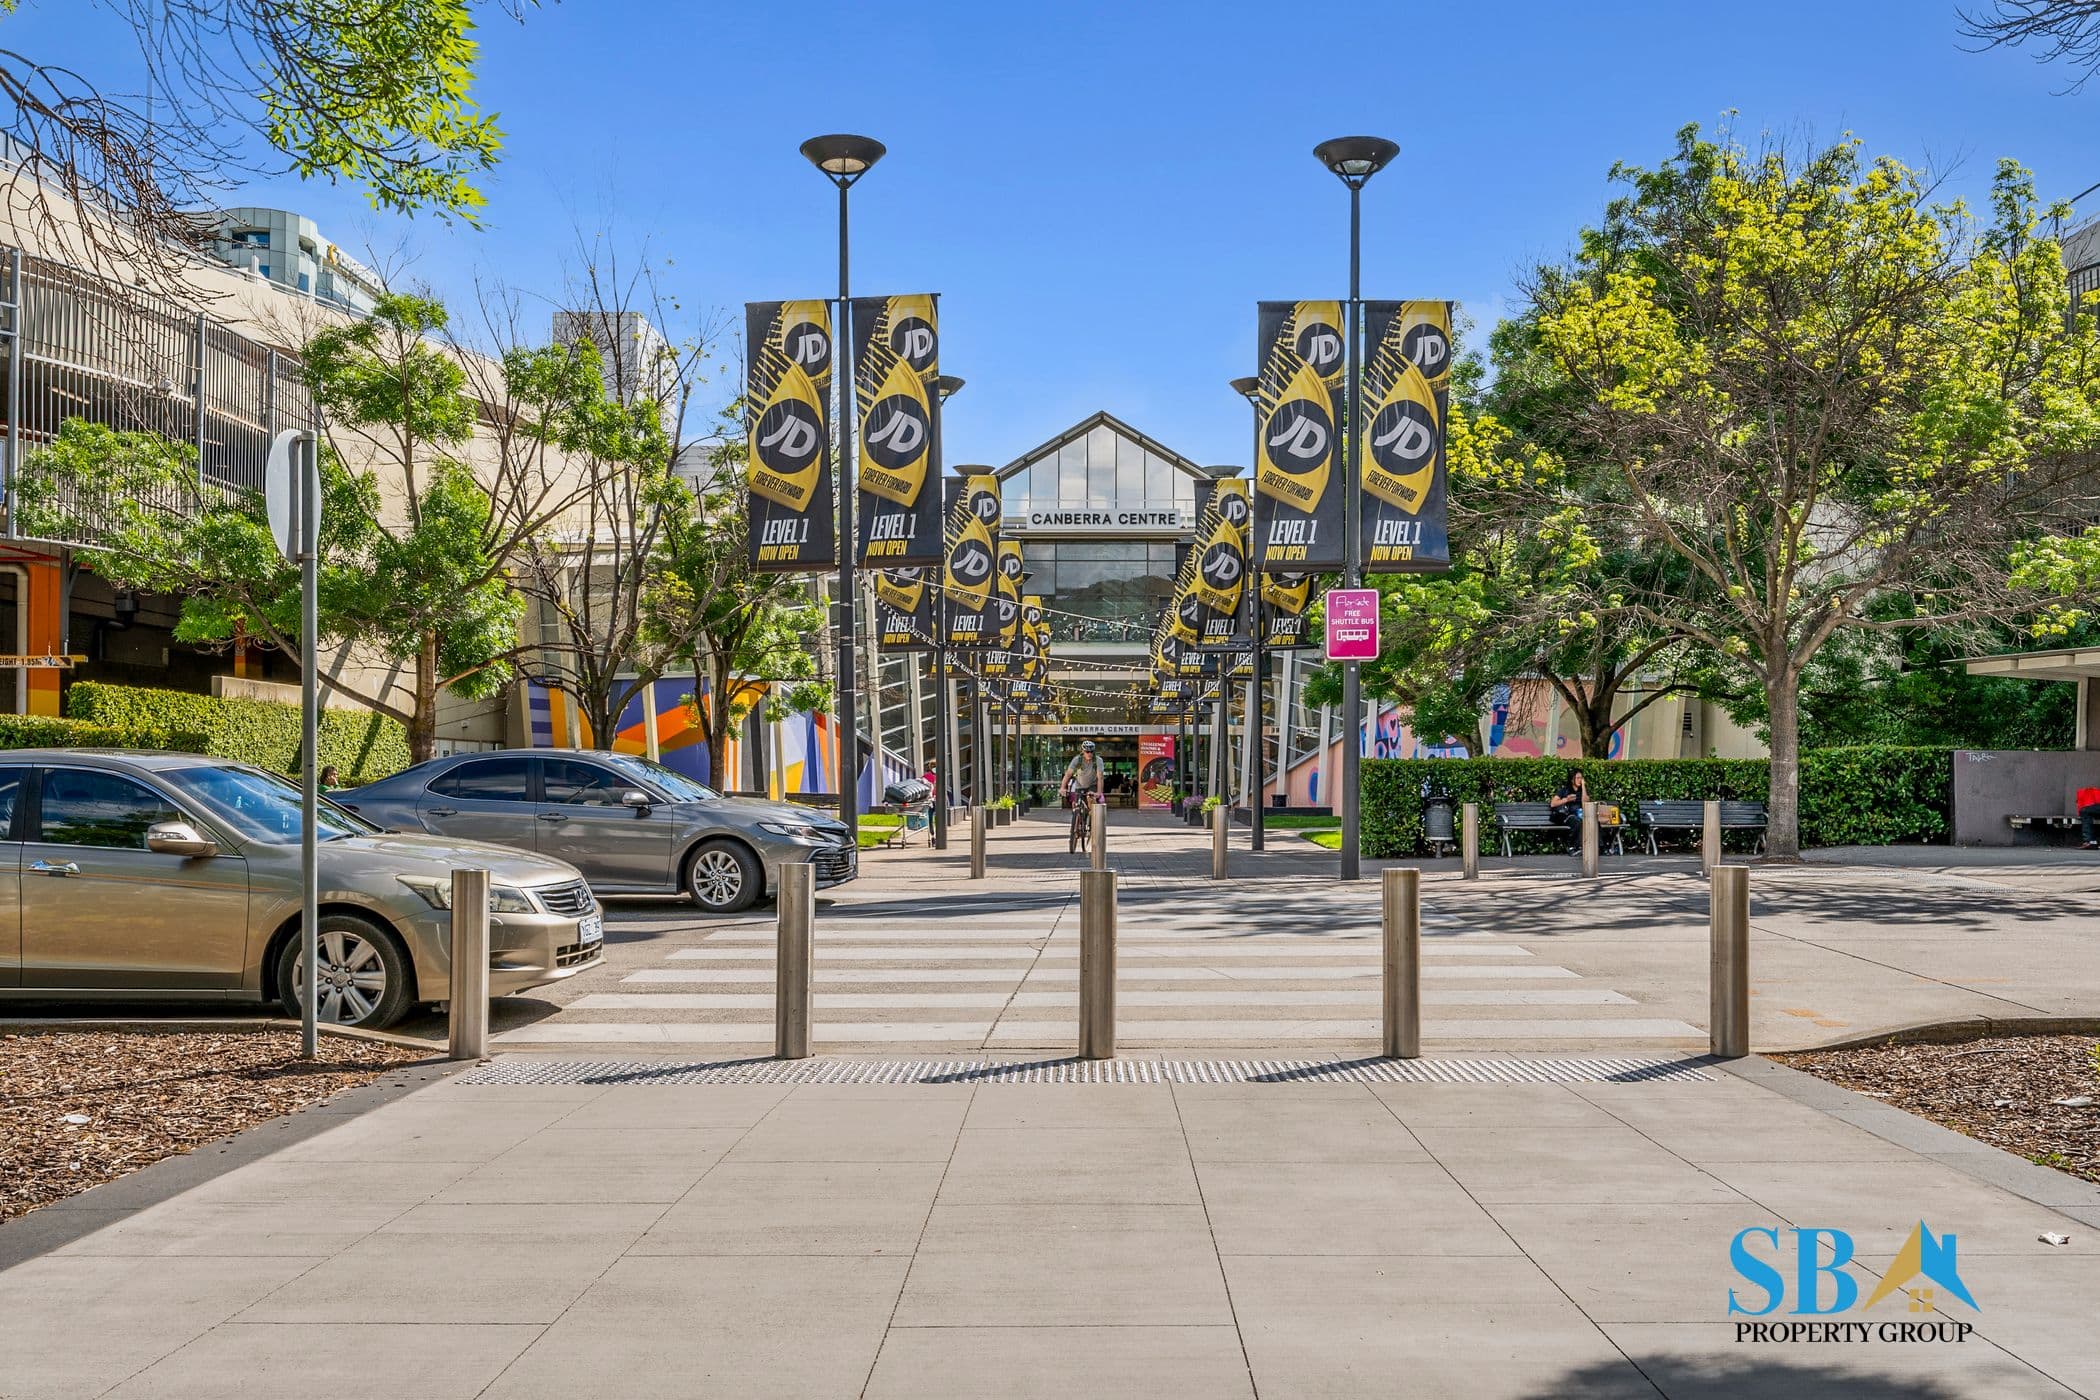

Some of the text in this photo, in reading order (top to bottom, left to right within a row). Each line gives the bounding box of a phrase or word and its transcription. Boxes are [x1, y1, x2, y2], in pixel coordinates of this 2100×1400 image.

[795, 333, 827, 364] JD
[901, 328, 933, 360] JD
[1306, 334, 1340, 365] JD
[1413, 335, 1446, 365] JD
[760, 414, 816, 457] JD
[868, 410, 923, 453] JD
[1269, 415, 1326, 458] JD
[1374, 416, 1431, 459] JD
[754, 470, 780, 491] FOREVER
[862, 467, 888, 488] FOREVER
[1261, 470, 1289, 491] FOREVER
[1366, 469, 1392, 492] FOREVER
[976, 498, 997, 518] JD
[1031, 513, 1176, 525] CANBERRA CENTRE
[1226, 500, 1247, 521] JD
[761, 518, 809, 545] LEVEL 1
[870, 513, 917, 540] LEVEL 1
[1268, 520, 1317, 545] LEVEL 1
[1373, 520, 1422, 545] LEVEL 1
[758, 545, 799, 560] NOW OPEN
[866, 540, 907, 557] NOW OPEN
[1265, 546, 1307, 560] NOW OPEN
[1371, 545, 1412, 560] NOW OPEN
[952, 549, 989, 577] JD
[1203, 552, 1239, 580] JD
[952, 615, 984, 632] LEVEL 1
[1205, 619, 1236, 635] LEVEL 1
